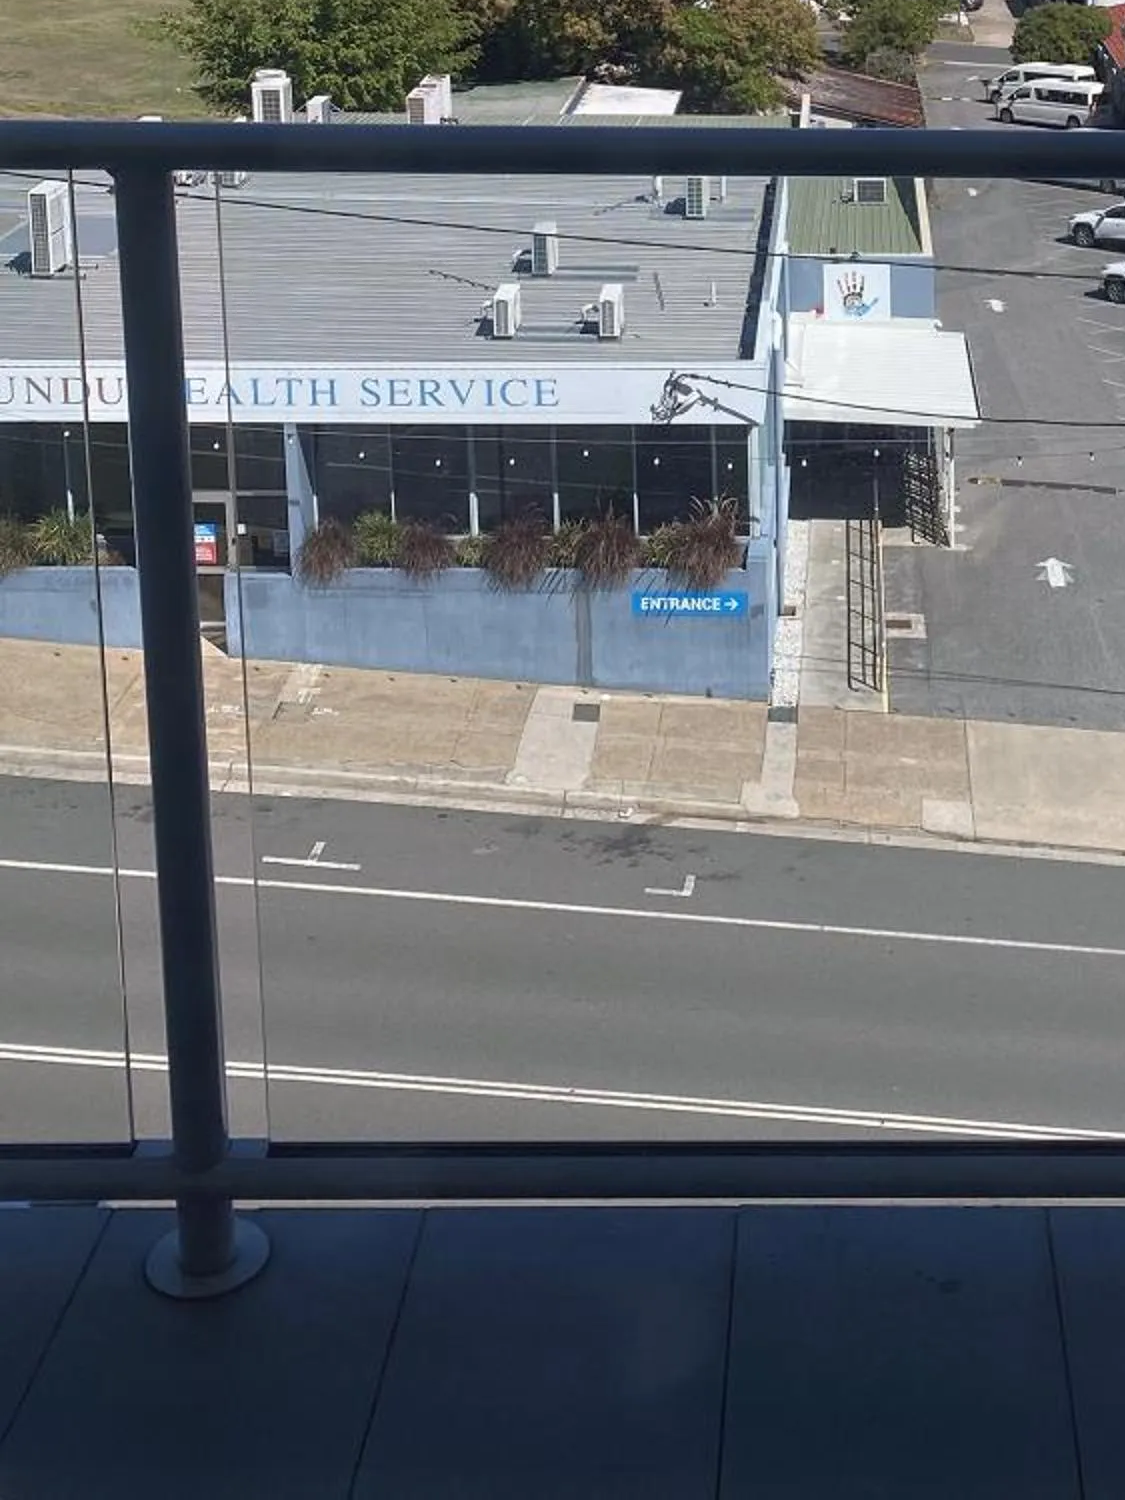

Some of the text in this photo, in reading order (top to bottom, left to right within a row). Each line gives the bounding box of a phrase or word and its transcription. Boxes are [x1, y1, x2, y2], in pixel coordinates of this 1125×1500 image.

[183, 377, 337, 407] EALTH
[360, 378, 560, 408] SERVICE
[640, 597, 721, 611] ENTRANCE
